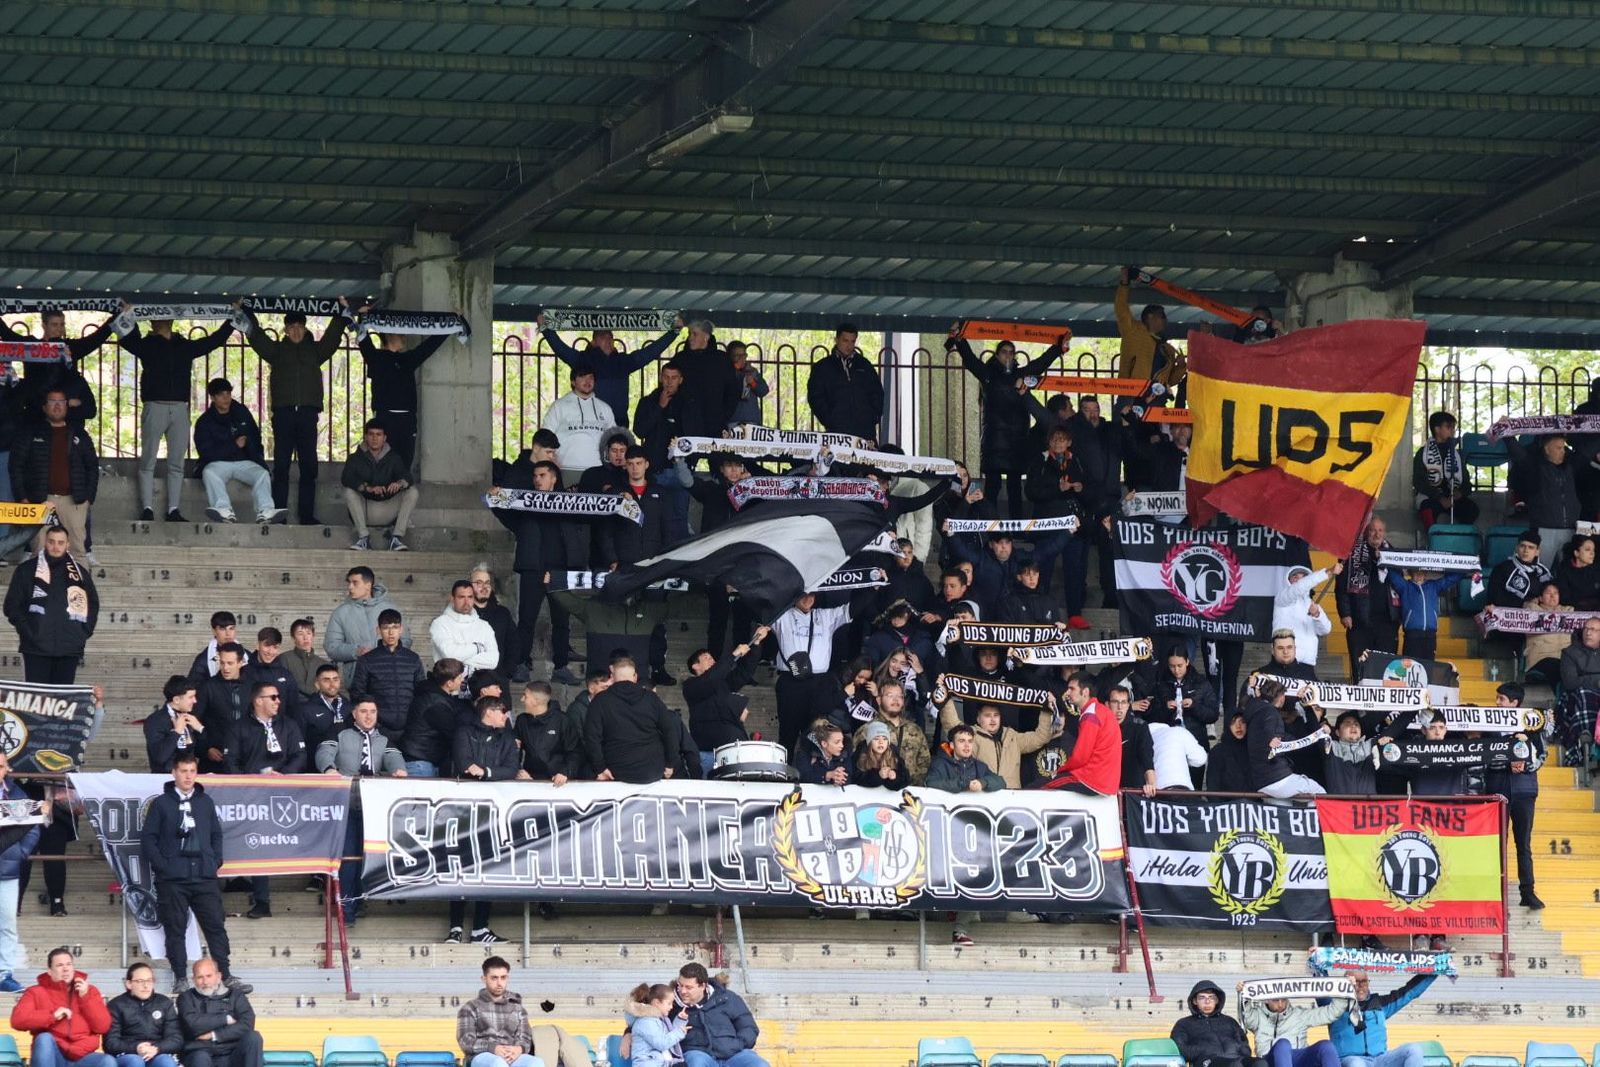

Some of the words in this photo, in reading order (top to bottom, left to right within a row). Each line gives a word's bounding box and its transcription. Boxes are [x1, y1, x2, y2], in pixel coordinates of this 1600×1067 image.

[134, 306, 171, 318] SOMOS
[244, 297, 340, 314] SALAMANCA
[362, 313, 437, 329] SALAMANCA
[567, 311, 660, 328] SALAMANCA
[751, 427, 774, 442] UDS
[779, 430, 818, 445] YOUNG
[822, 433, 852, 448] BOYS
[1220, 398, 1385, 474] UDS
[523, 492, 618, 513] SALAMANCA
[130, 523, 150, 534] 12
[194, 524, 213, 535] 10
[261, 525, 270, 536] 8
[1117, 519, 1155, 545] UDS
[1163, 526, 1229, 546] YOUNG
[1237, 526, 1287, 551] BOYS
[1405, 556, 1440, 564] DEPORTIVA
[150, 570, 170, 580] 12
[213, 571, 234, 582] 10
[109, 612, 129, 623] 14
[174, 613, 194, 624] 12
[1155, 612, 1199, 628] SECCIÓN
[1200, 619, 1255, 636] FEMENINA
[963, 626, 988, 640] UDS
[991, 626, 1031, 643] YOUNG
[1034, 627, 1064, 642] BOYS
[1033, 647, 1057, 659] UDS
[1058, 645, 1097, 657] YOUNG
[1100, 641, 1130, 656] BOYS
[132, 657, 152, 669] 14
[945, 677, 969, 694] UDS
[973, 682, 1013, 701] YOUNG
[1017, 688, 1049, 704] BOYS
[1319, 685, 1342, 702] UDS
[1344, 687, 1386, 703] YOUNG
[1390, 689, 1421, 705] BOYS
[1485, 710, 1518, 726] BOYS
[1406, 743, 1464, 754] SALAMANCA
[1468, 743, 1484, 753] C.F.
[1489, 741, 1510, 751] UDS
[300, 803, 345, 822] CREW
[1140, 800, 1190, 834] UDS
[1198, 803, 1280, 834] YOUNG
[1352, 804, 1399, 830] UDS
[1404, 804, 1467, 832] FANS
[386, 795, 790, 894] SALAMANCA
[920, 805, 1105, 902] 1923
[1549, 839, 1572, 854] 13
[1140, 855, 1205, 879] ¡Hala
[823, 885, 898, 905] ULTRAS
[1231, 913, 1257, 926] 1923
[1366, 915, 1428, 928] CASTELLANOS
[1430, 915, 1442, 928] DE
[1446, 915, 1498, 928] VILLIQUERA
[270, 946, 291, 957] 14
[410, 946, 429, 957] 10
[823, 944, 831, 956] 3
[955, 947, 963, 959] 7
[1079, 948, 1097, 960] 11
[1274, 953, 1292, 965] 17
[1333, 950, 1408, 964] SALAMANCA
[1410, 953, 1435, 965] UDS
[1463, 955, 1483, 966] 23
[1528, 957, 1548, 969] 25
[1247, 981, 1334, 998] SALMANTINO
[985, 996, 993, 1009] 7
[1503, 1003, 1523, 1016] 23
[1567, 1004, 1587, 1019] 25
